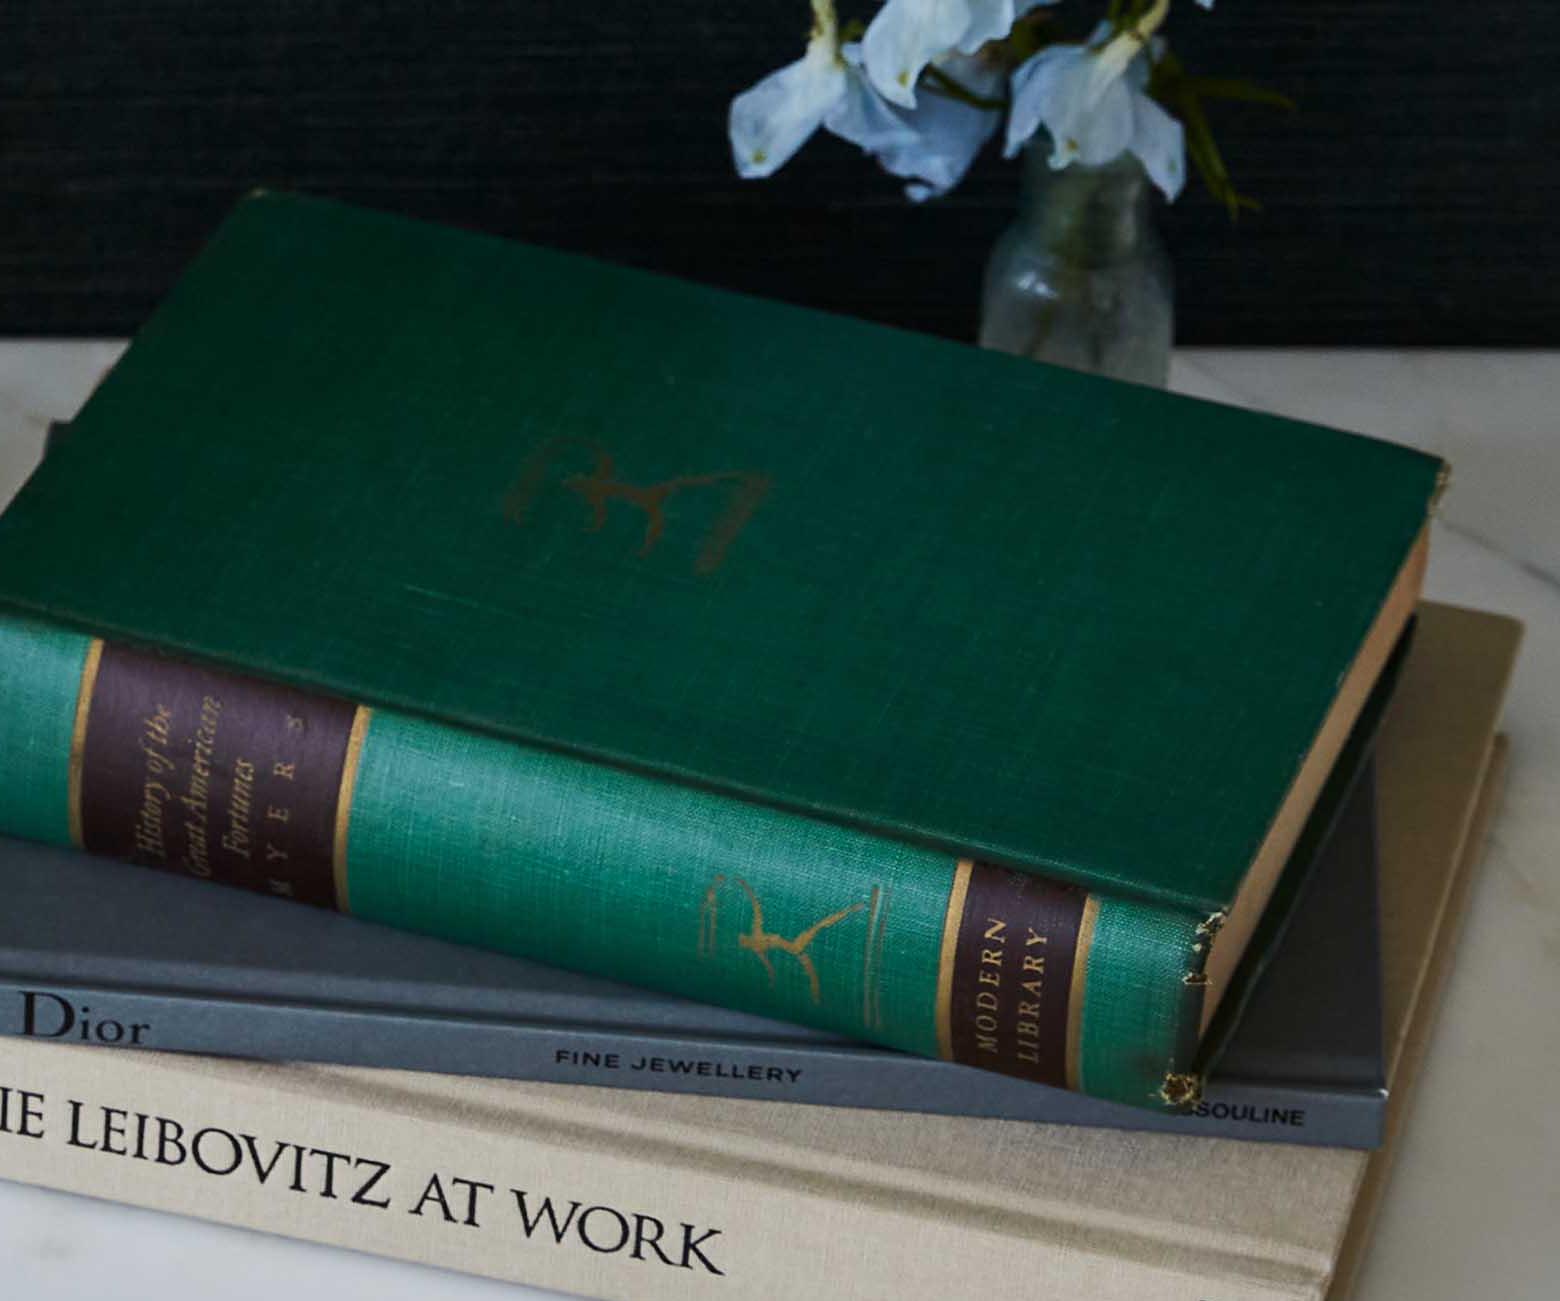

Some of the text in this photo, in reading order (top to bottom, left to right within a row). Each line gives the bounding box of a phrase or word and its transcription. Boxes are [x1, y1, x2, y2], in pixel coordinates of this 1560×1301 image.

[142, 703, 173, 746] the
[143, 746, 175, 775] of
[221, 757, 257, 860] Fortunes
[975, 917, 1008, 1053] MODERN
[1017, 927, 1049, 1064] LIBRARY
[18, 990, 151, 1044] Dior
[555, 1050, 802, 1083] FINE JEWELLERY
[1182, 1101, 1305, 1127] SOULINE
[67, 1100, 390, 1208] LEIBOVITZ
[409, 1173, 494, 1228] AT
[511, 1189, 725, 1276] WORK
